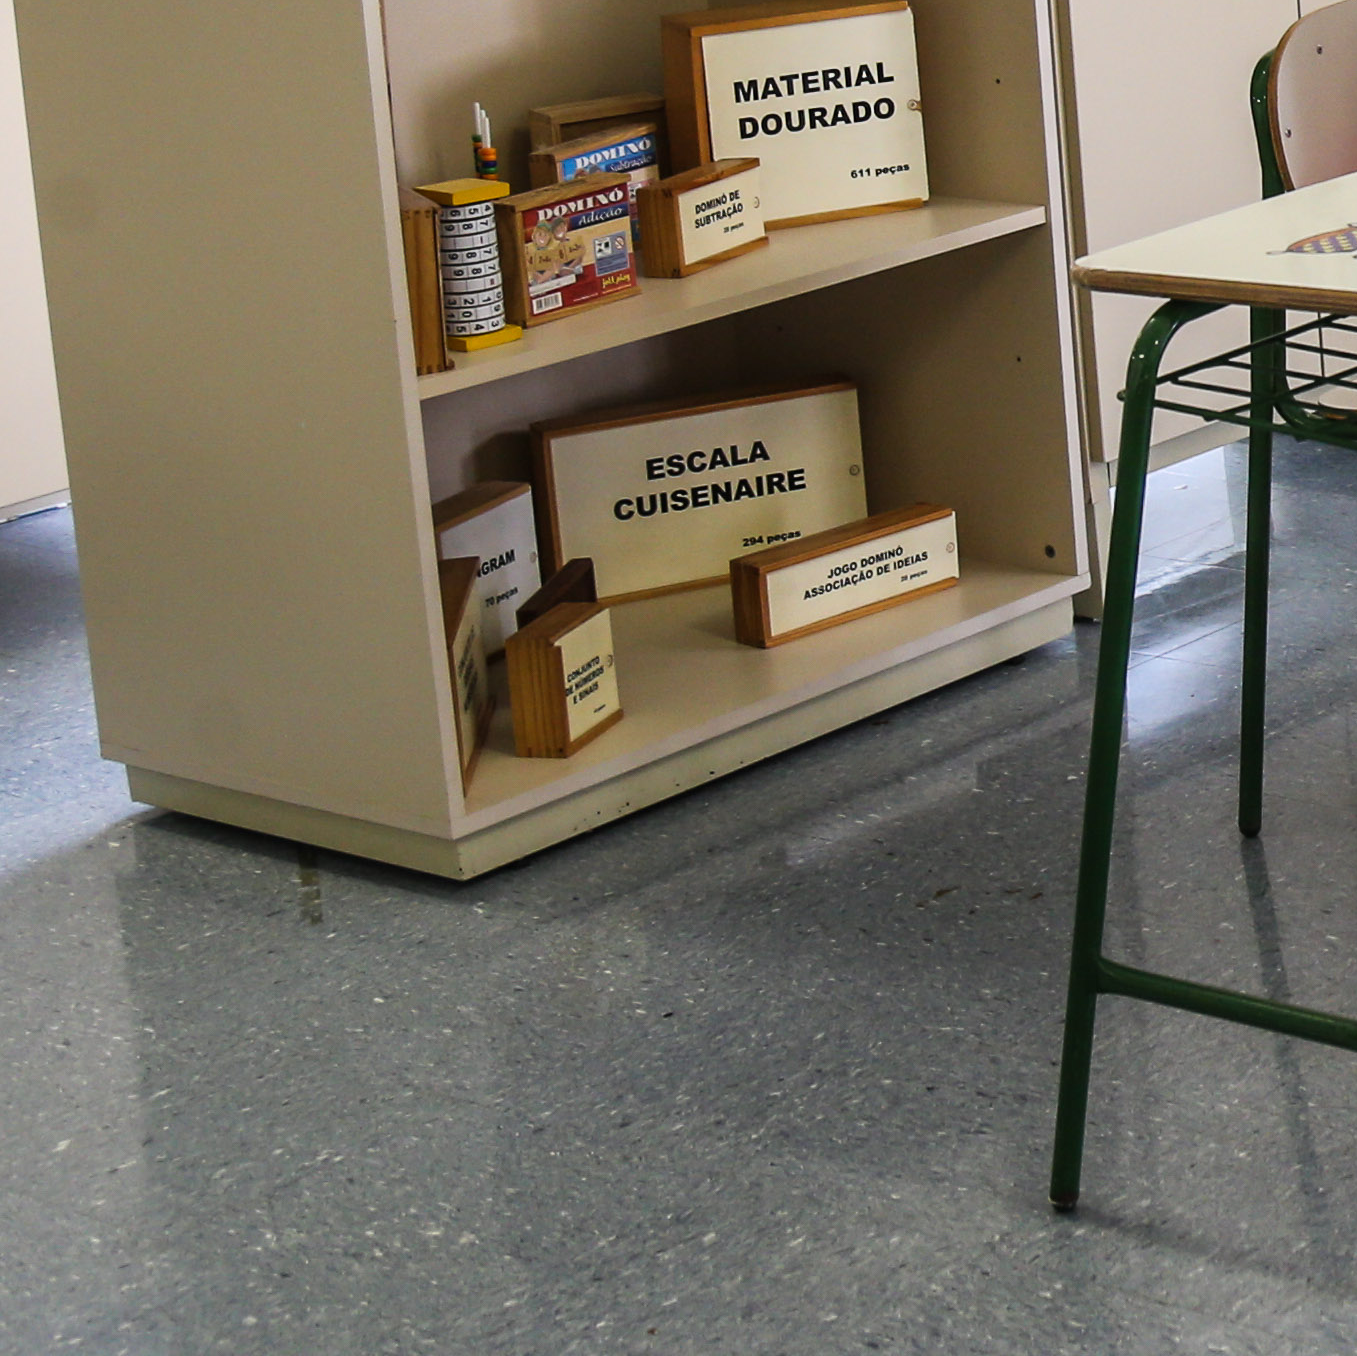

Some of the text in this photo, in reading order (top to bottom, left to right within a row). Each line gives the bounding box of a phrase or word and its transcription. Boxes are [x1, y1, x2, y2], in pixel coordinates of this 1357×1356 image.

[733, 61, 895, 104] MATERIAL
[738, 97, 895, 140] DOURADO
[575, 137, 652, 170] DOMINÓ
[850, 163, 910, 179] 611 peças
[537, 187, 624, 221] DOMINÓ
[694, 189, 741, 215] DOMINÓ DE
[694, 202, 744, 229] SUBTRAÇÃO
[645, 441, 771, 481] ESCALA
[613, 468, 807, 521] CUISENAIRE
[742, 531, 802, 547] 294 peças
[477, 549, 516, 578] GRAM
[803, 551, 929, 600] ASSOCIAÇÃO DE IDEIAS
[827, 545, 904, 579] JOGO DOMINÓ
[567, 655, 600, 683] CONJUNTO
[565, 685, 574, 697] DE
